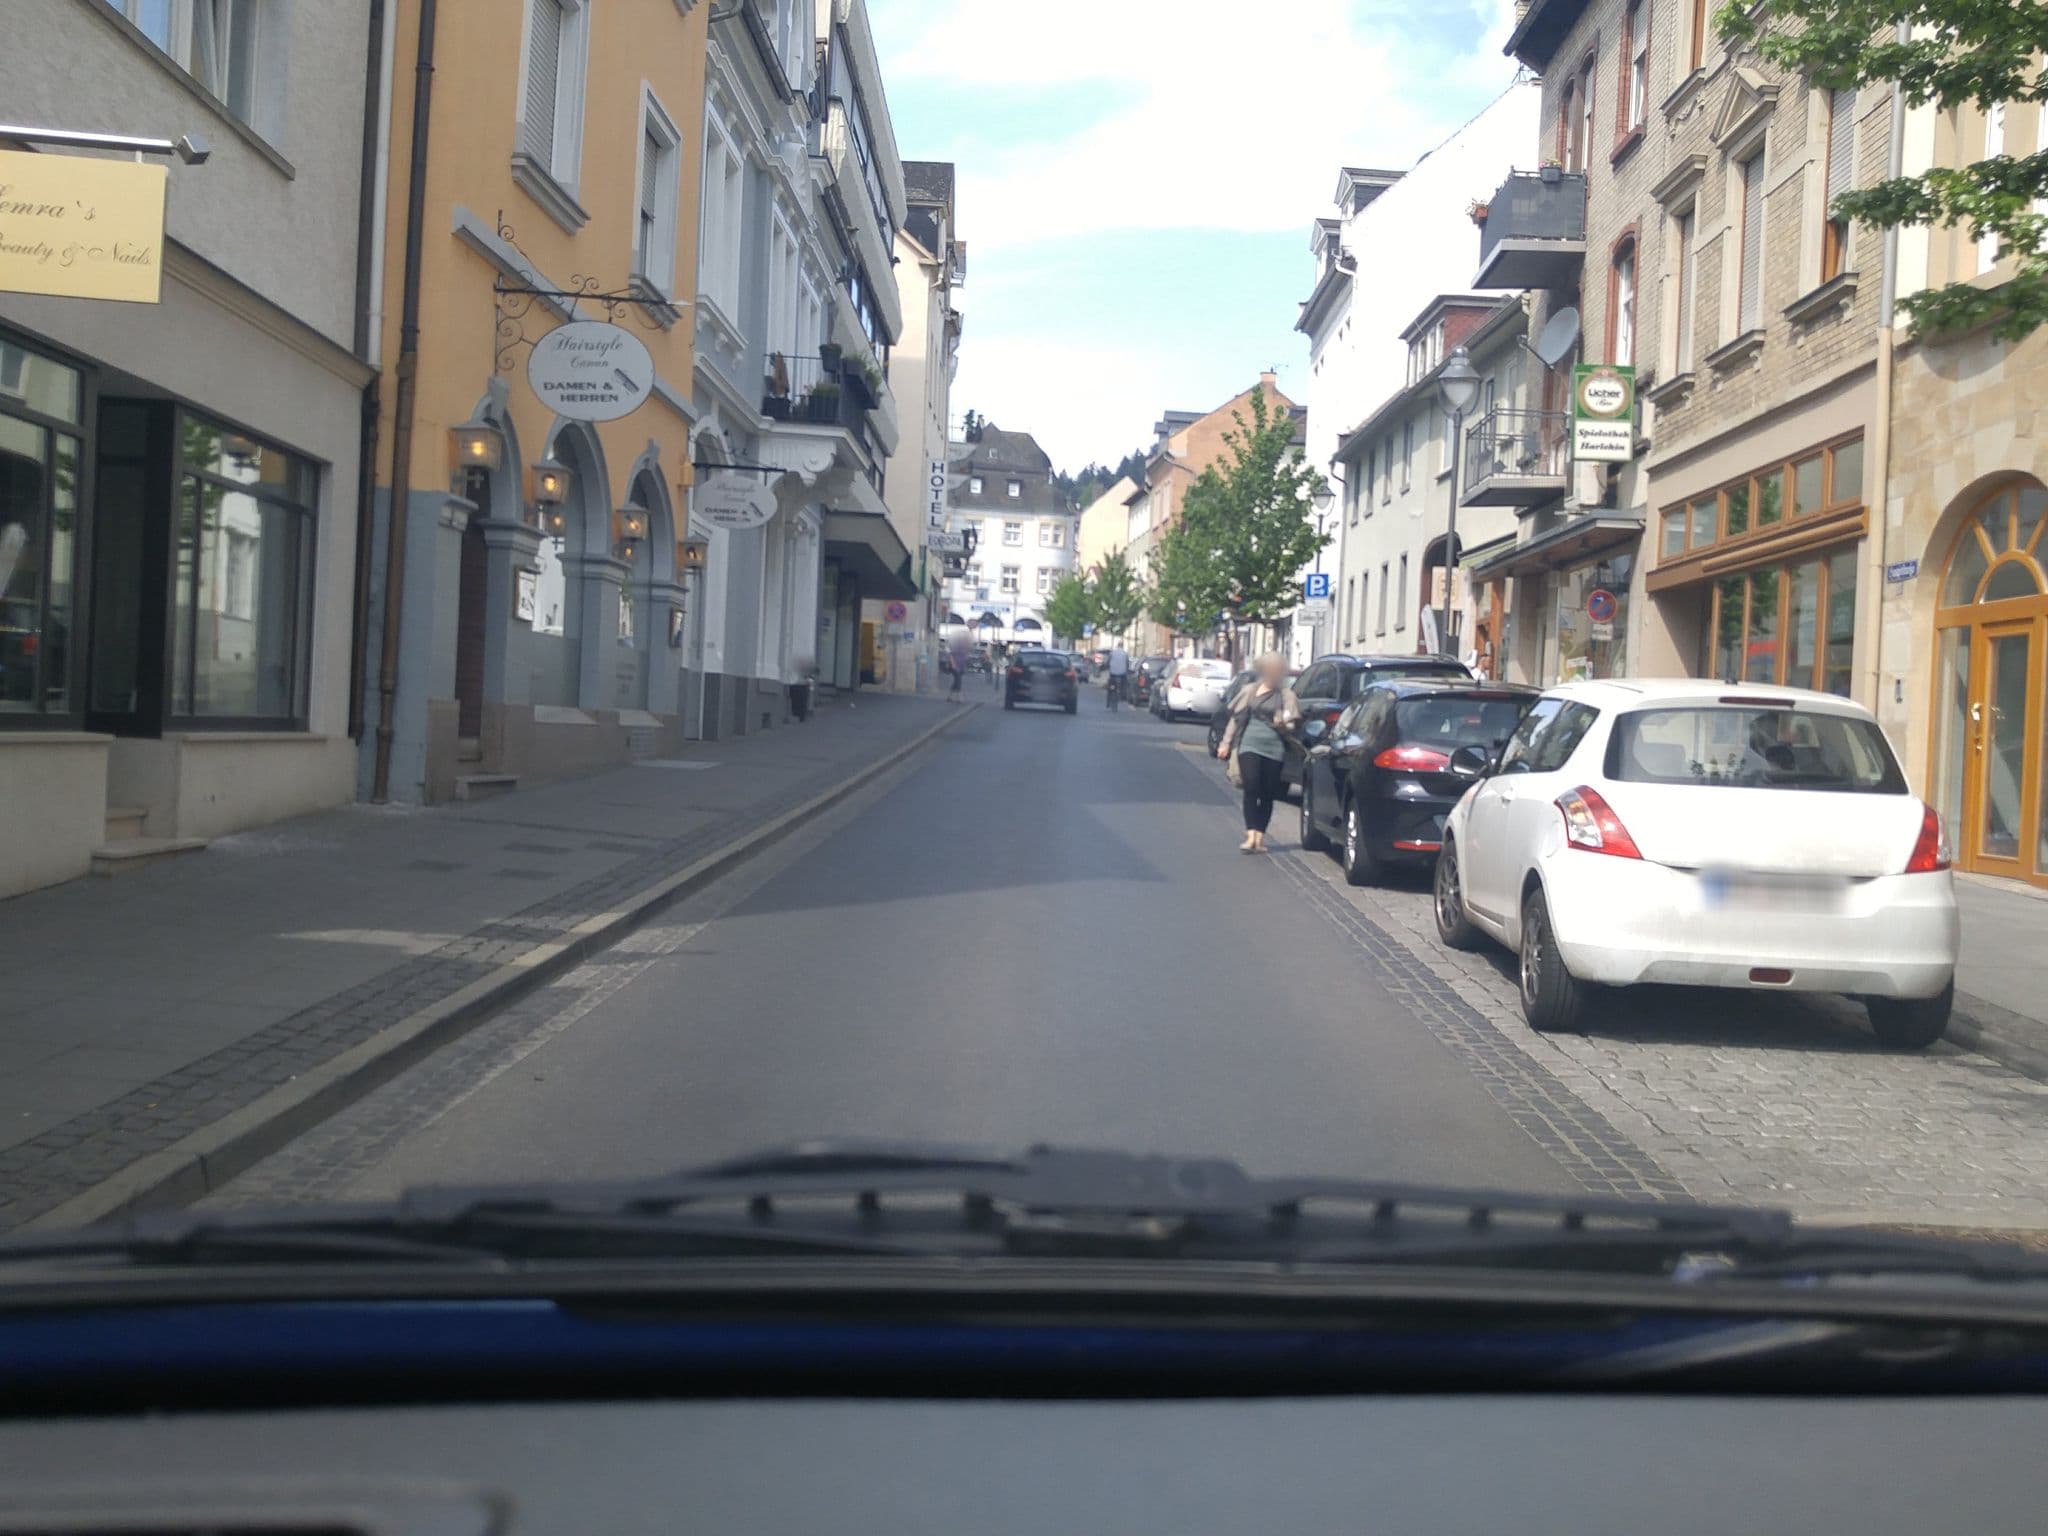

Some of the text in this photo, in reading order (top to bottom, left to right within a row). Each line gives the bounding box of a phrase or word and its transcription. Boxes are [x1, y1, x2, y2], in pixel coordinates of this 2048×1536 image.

[87, 243, 152, 265] Nails
[553, 332, 624, 357] Hairstyle
[543, 382, 613, 391] DAMEN &
[560, 394, 619, 402] HERREN
[930, 462, 945, 528] HOTEL
[1310, 575, 1325, 596] P
